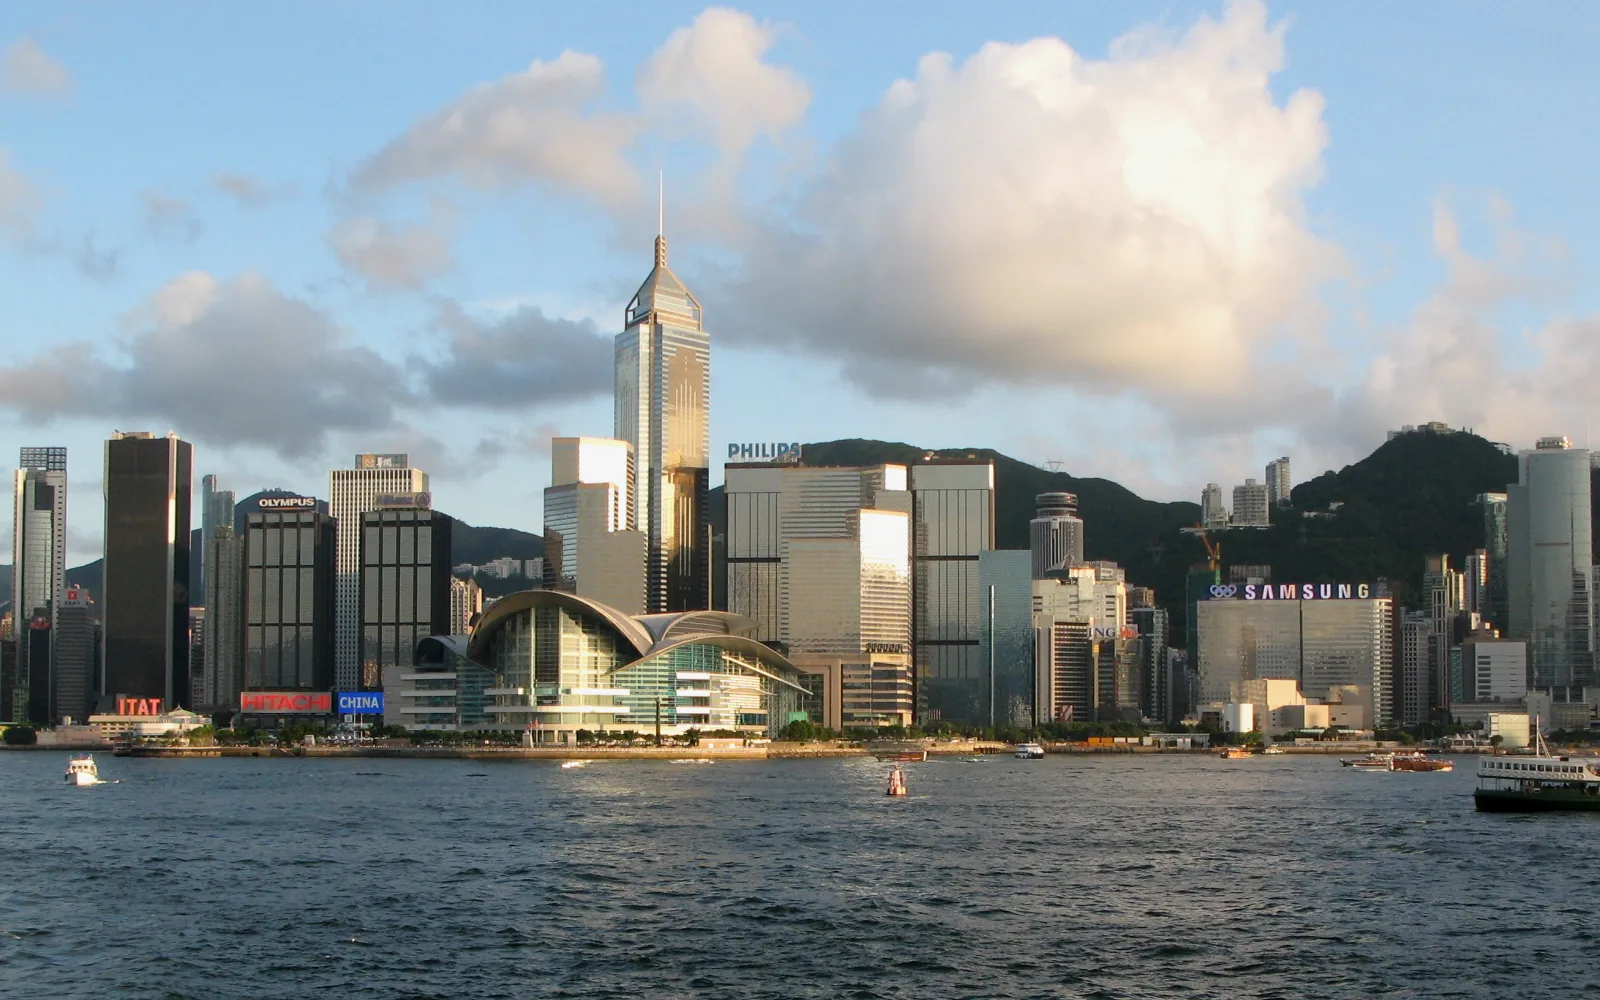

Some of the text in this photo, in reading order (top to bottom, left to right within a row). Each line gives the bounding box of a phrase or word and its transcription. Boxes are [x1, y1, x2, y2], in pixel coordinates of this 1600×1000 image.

[728, 442, 799, 458] PHILIPS
[259, 498, 315, 507] OLYMPUS
[1244, 583, 1370, 600] SAMSUNG
[119, 698, 160, 716] ITAT
[242, 694, 331, 711] HITACHI
[339, 696, 380, 709] CHINA
